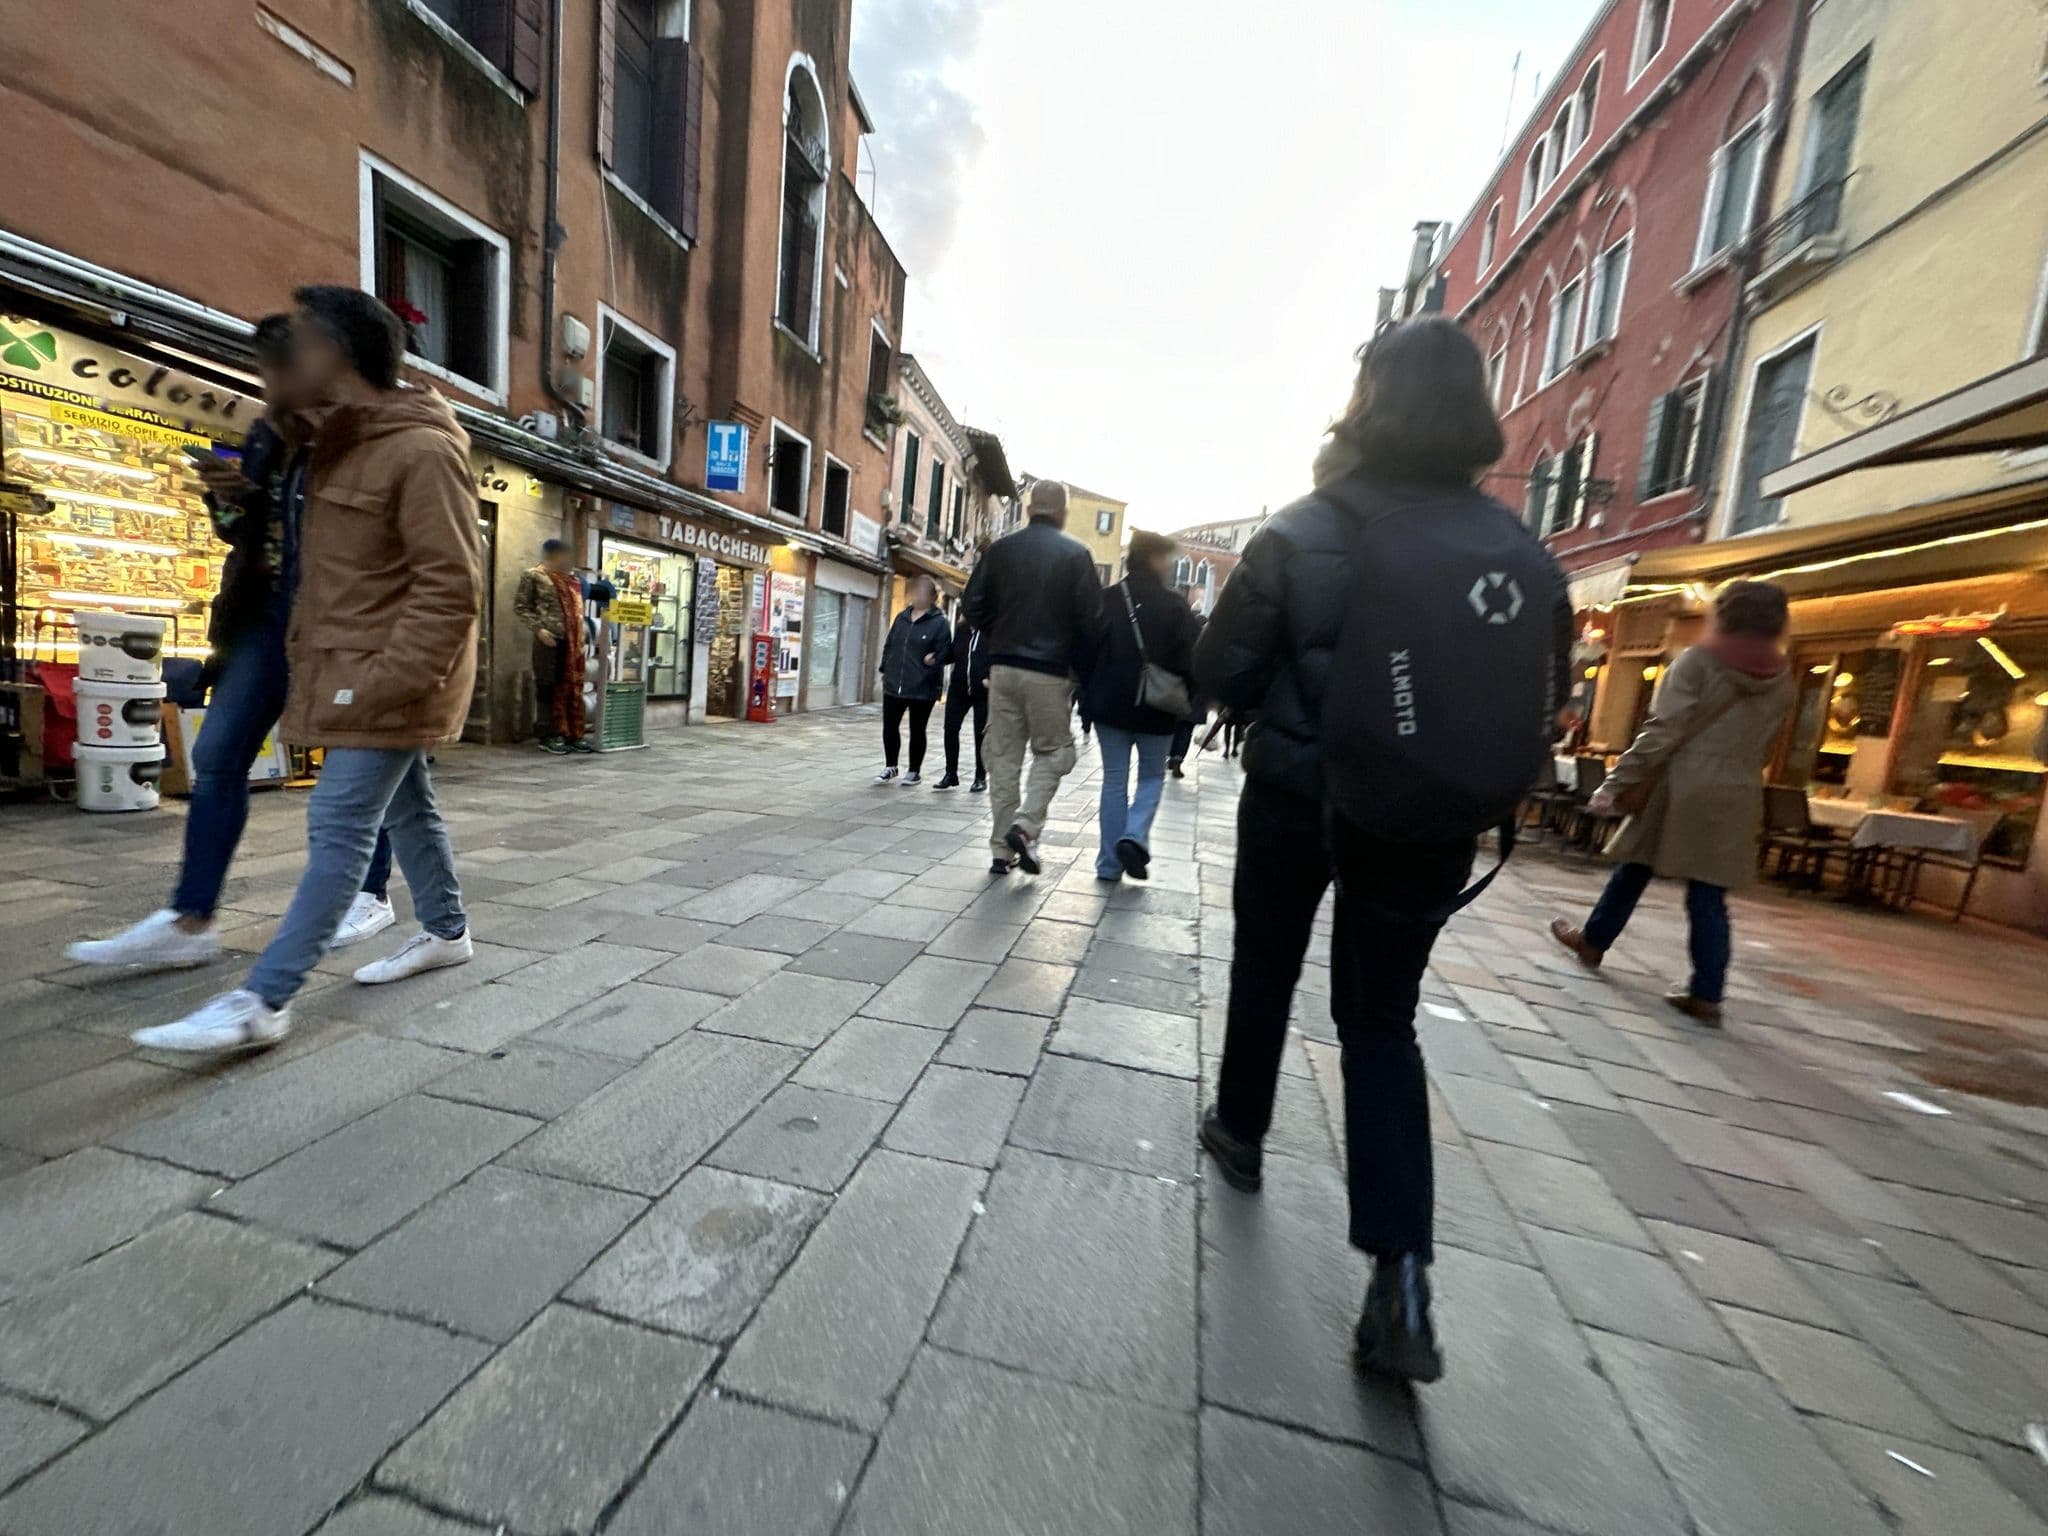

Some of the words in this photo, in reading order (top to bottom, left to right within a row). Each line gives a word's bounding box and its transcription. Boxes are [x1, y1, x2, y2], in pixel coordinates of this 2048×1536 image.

[64, 409, 120, 430] SERVIZIO
[125, 424, 159, 439] COPIE
[714, 425, 737, 461] T
[659, 516, 772, 565] TABACCHERIA
[1390, 648, 1418, 736] XLMOTO
